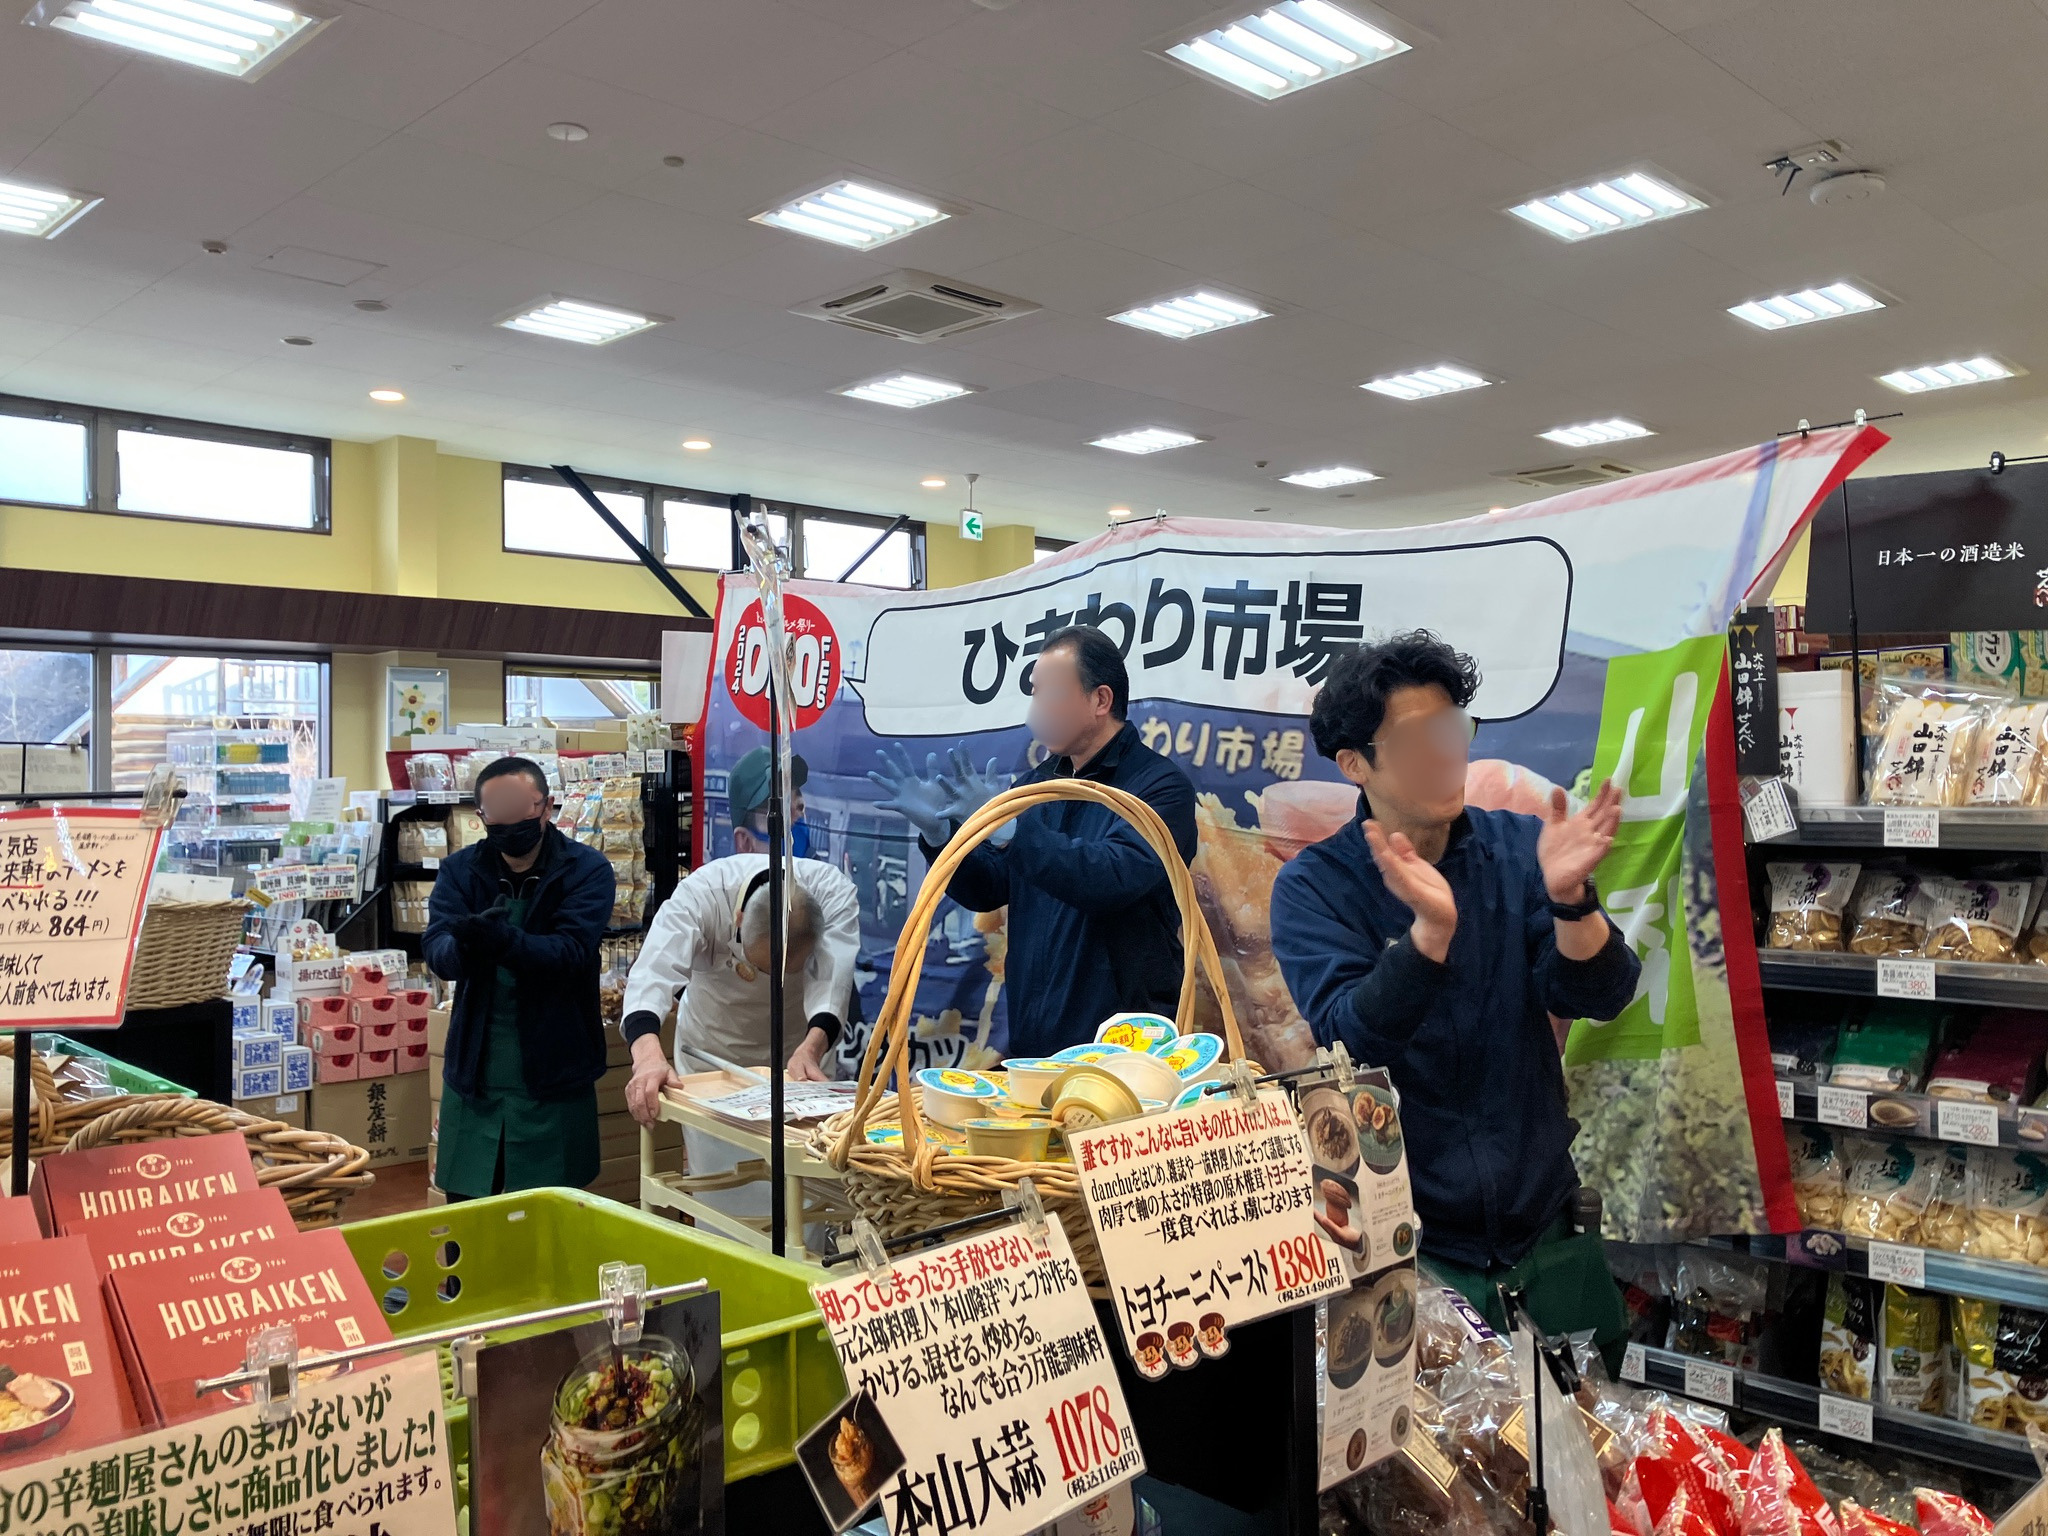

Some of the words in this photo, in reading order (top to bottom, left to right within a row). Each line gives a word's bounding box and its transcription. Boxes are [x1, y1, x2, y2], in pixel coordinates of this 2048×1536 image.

[1878, 541, 2026, 566] 日本一の酒造米
[731, 625, 746, 695] 2024
[816, 636, 832, 710] FES
[1903, 722, 1934, 781] 山田錦
[0, 976, 111, 1006] 人前食べてしまいます。
[1144, 1183, 1313, 1245] 一度食べれば、虜になります
[158, 1268, 348, 1340] HOURAIKEN
[1120, 1249, 1268, 1335] トヨチーニペースト
[1277, 1274, 1344, 1303] (税込1490円)
[940, 1325, 1105, 1419] なんでも合う万能調味料
[1066, 1449, 1141, 1499] (税込1164円)
